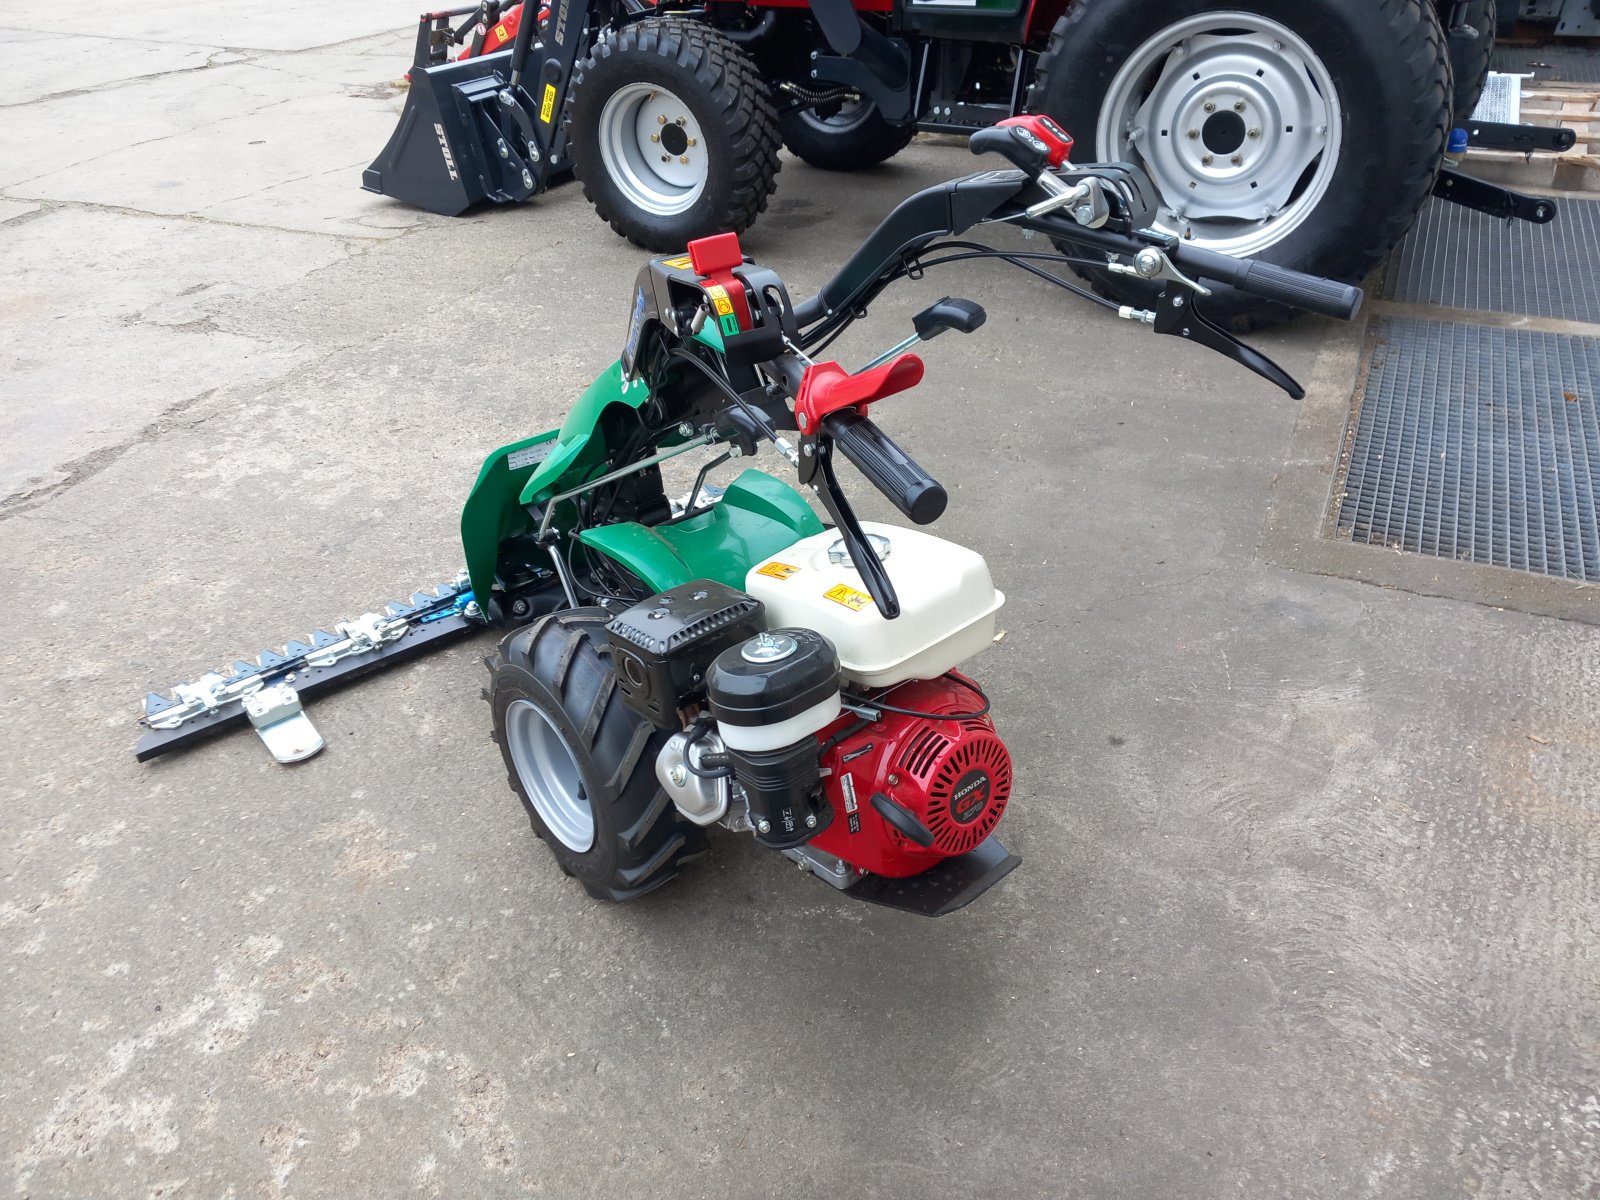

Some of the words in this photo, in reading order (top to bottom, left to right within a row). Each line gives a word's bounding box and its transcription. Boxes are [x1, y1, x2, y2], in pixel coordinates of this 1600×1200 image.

[433, 123, 458, 181] STOLL
[953, 776, 987, 801] HONDA
[956, 785, 986, 814] GX
